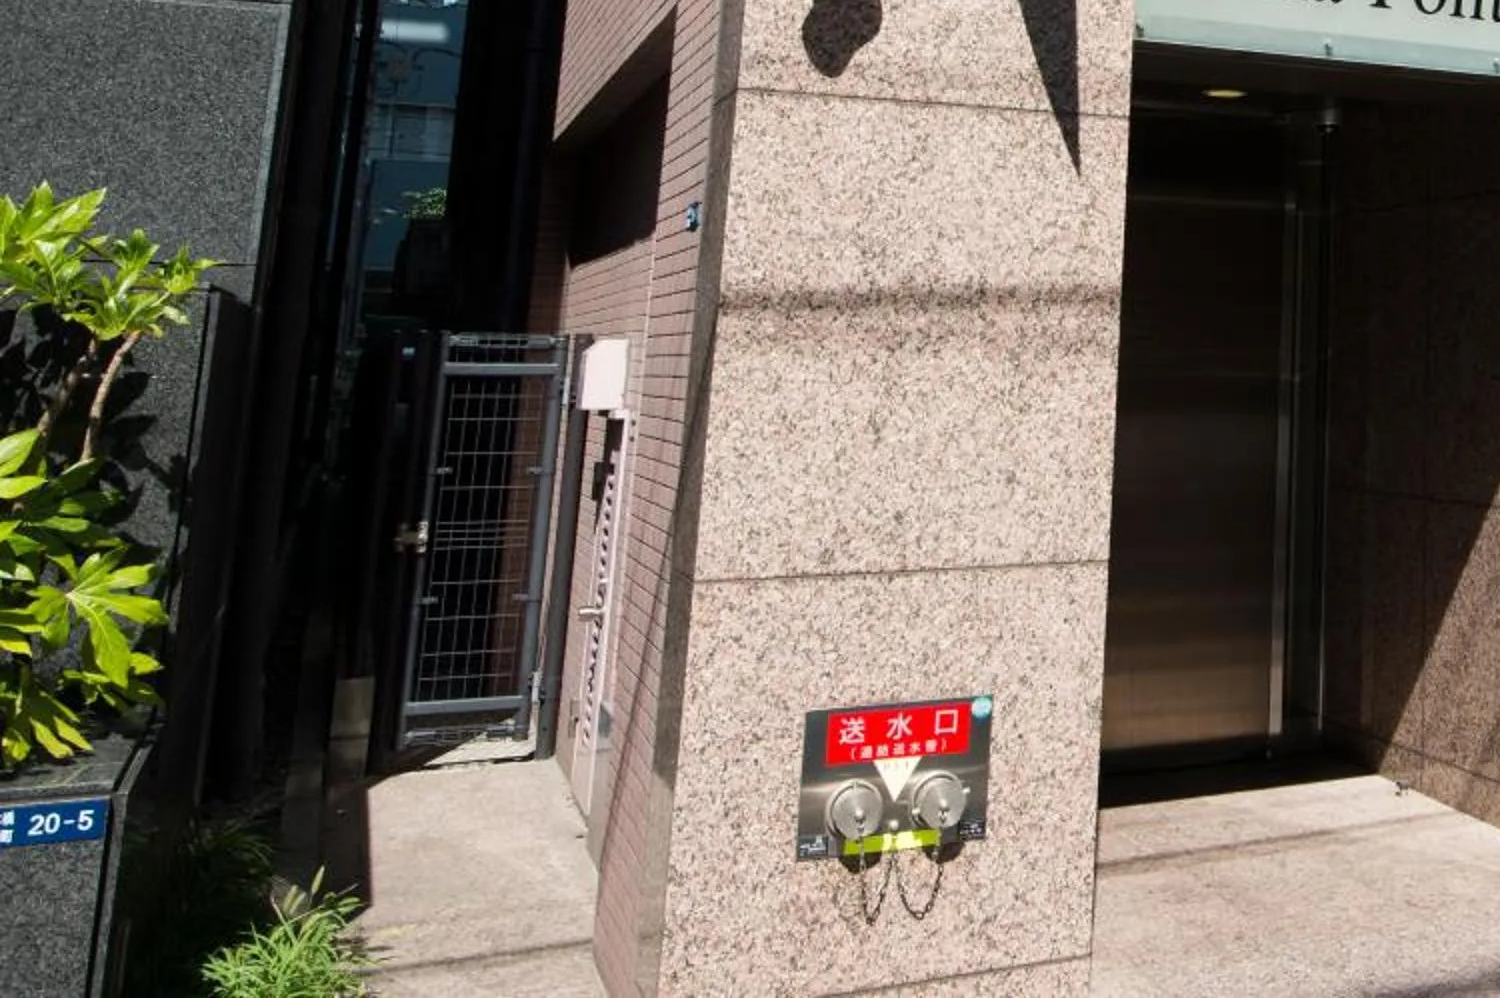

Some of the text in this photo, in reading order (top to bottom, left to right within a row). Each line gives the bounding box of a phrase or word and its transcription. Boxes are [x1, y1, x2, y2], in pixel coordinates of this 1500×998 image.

[838, 709, 959, 745] 送水口
[27, 809, 95, 836] 20-5
